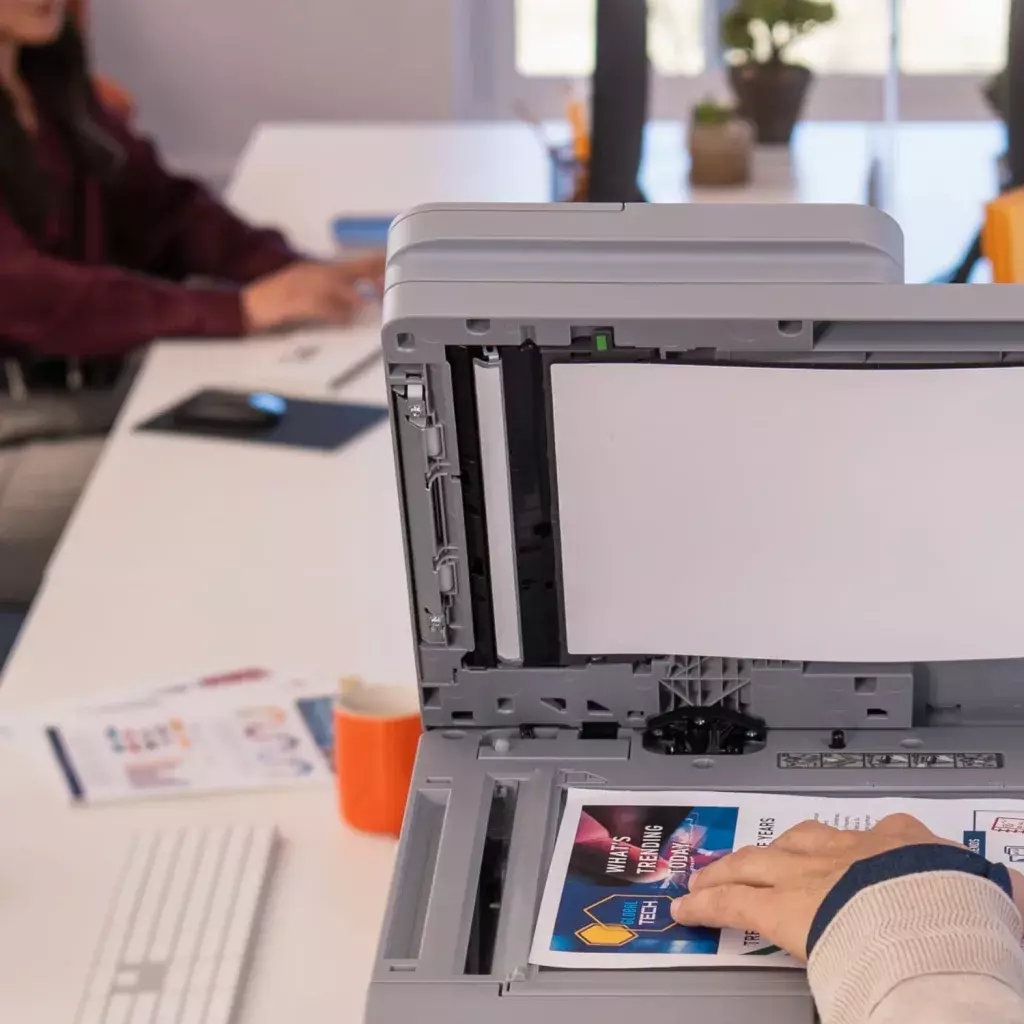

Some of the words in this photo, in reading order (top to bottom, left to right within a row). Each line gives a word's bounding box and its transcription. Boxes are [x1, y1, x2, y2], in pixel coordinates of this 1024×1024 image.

[757, 817, 775, 840] YEARS
[606, 836, 631, 873] WHAT'S
[636, 825, 663, 874] TRENDING
[667, 842, 690, 873] TODAY
[621, 901, 638, 925] GLOBAL
[638, 901, 658, 925] TECH
